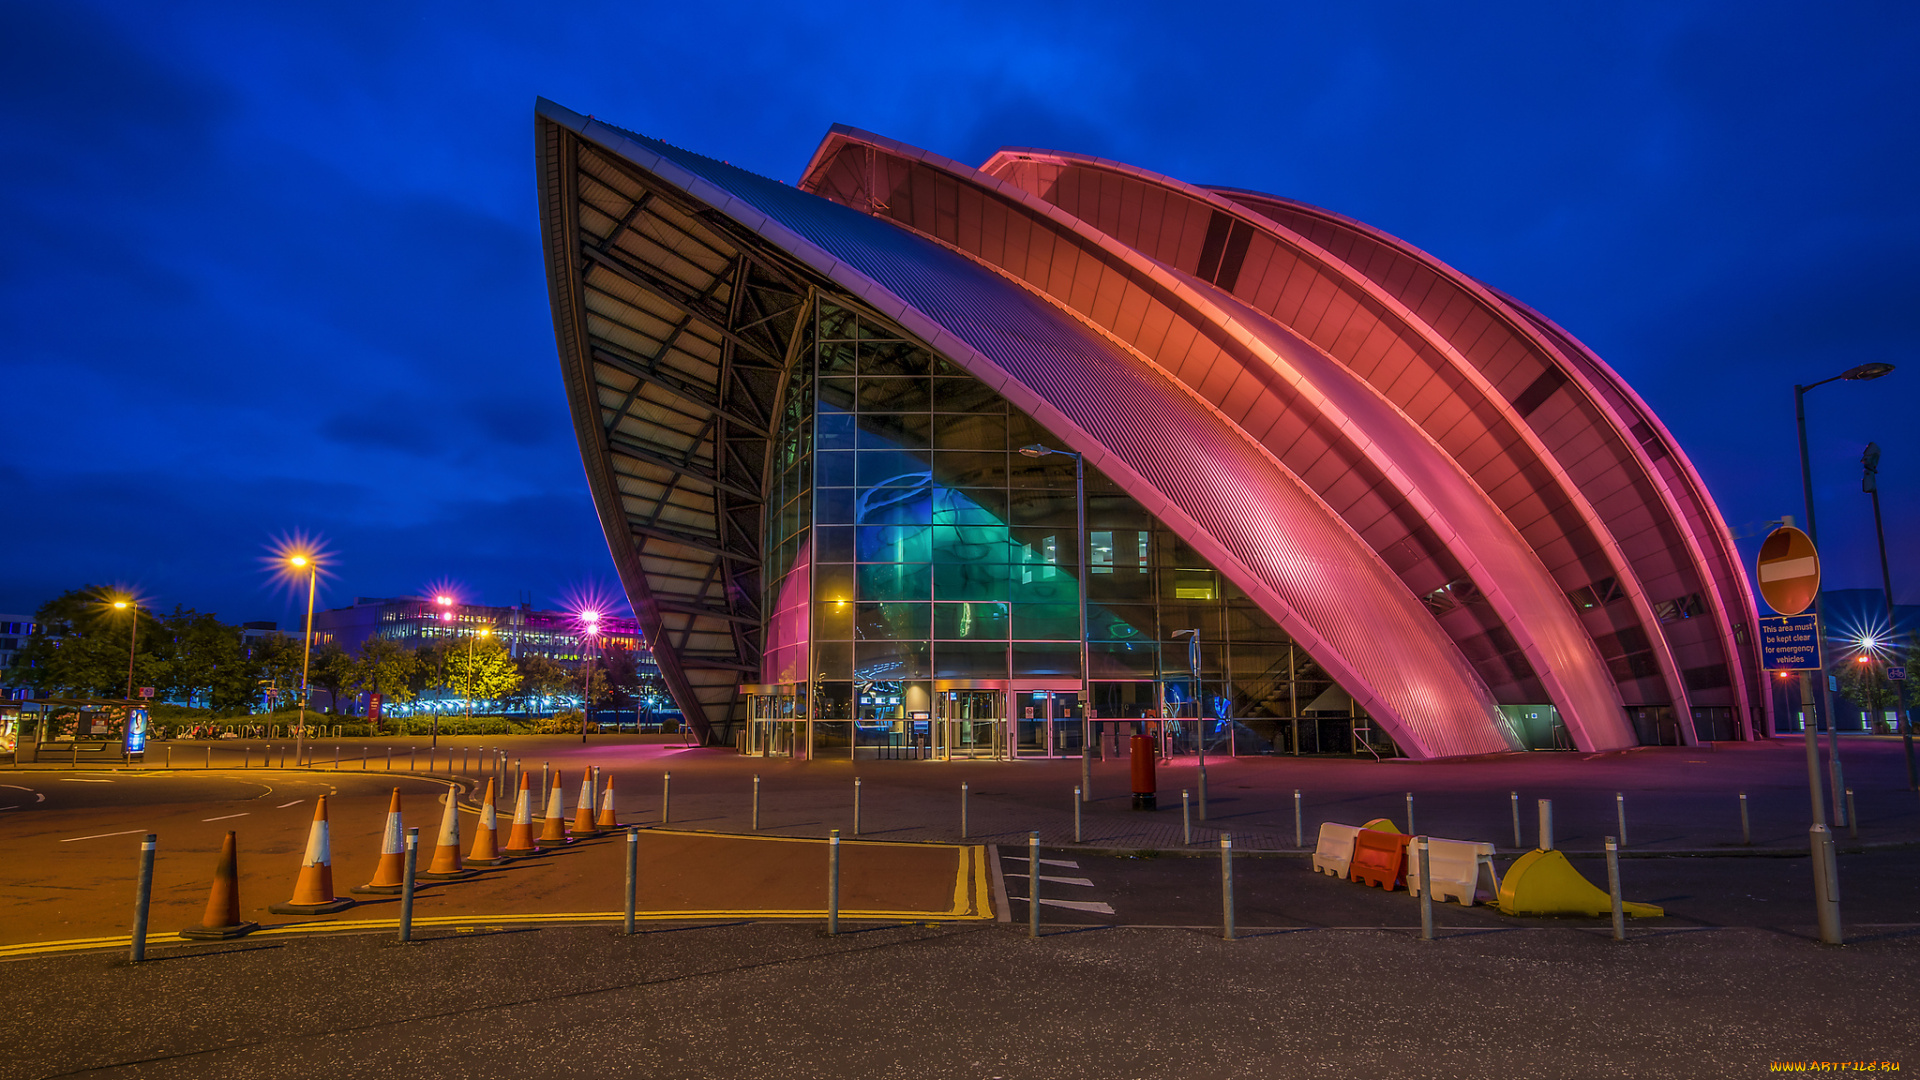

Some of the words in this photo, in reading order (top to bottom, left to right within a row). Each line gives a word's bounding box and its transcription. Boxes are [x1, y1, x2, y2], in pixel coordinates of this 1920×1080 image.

[1762, 625, 1777, 633] This
[1795, 623, 1813, 631] must
[1776, 635, 1792, 643] kept
[1776, 645, 1814, 654] emergency
[1776, 655, 1805, 663] vehicles
